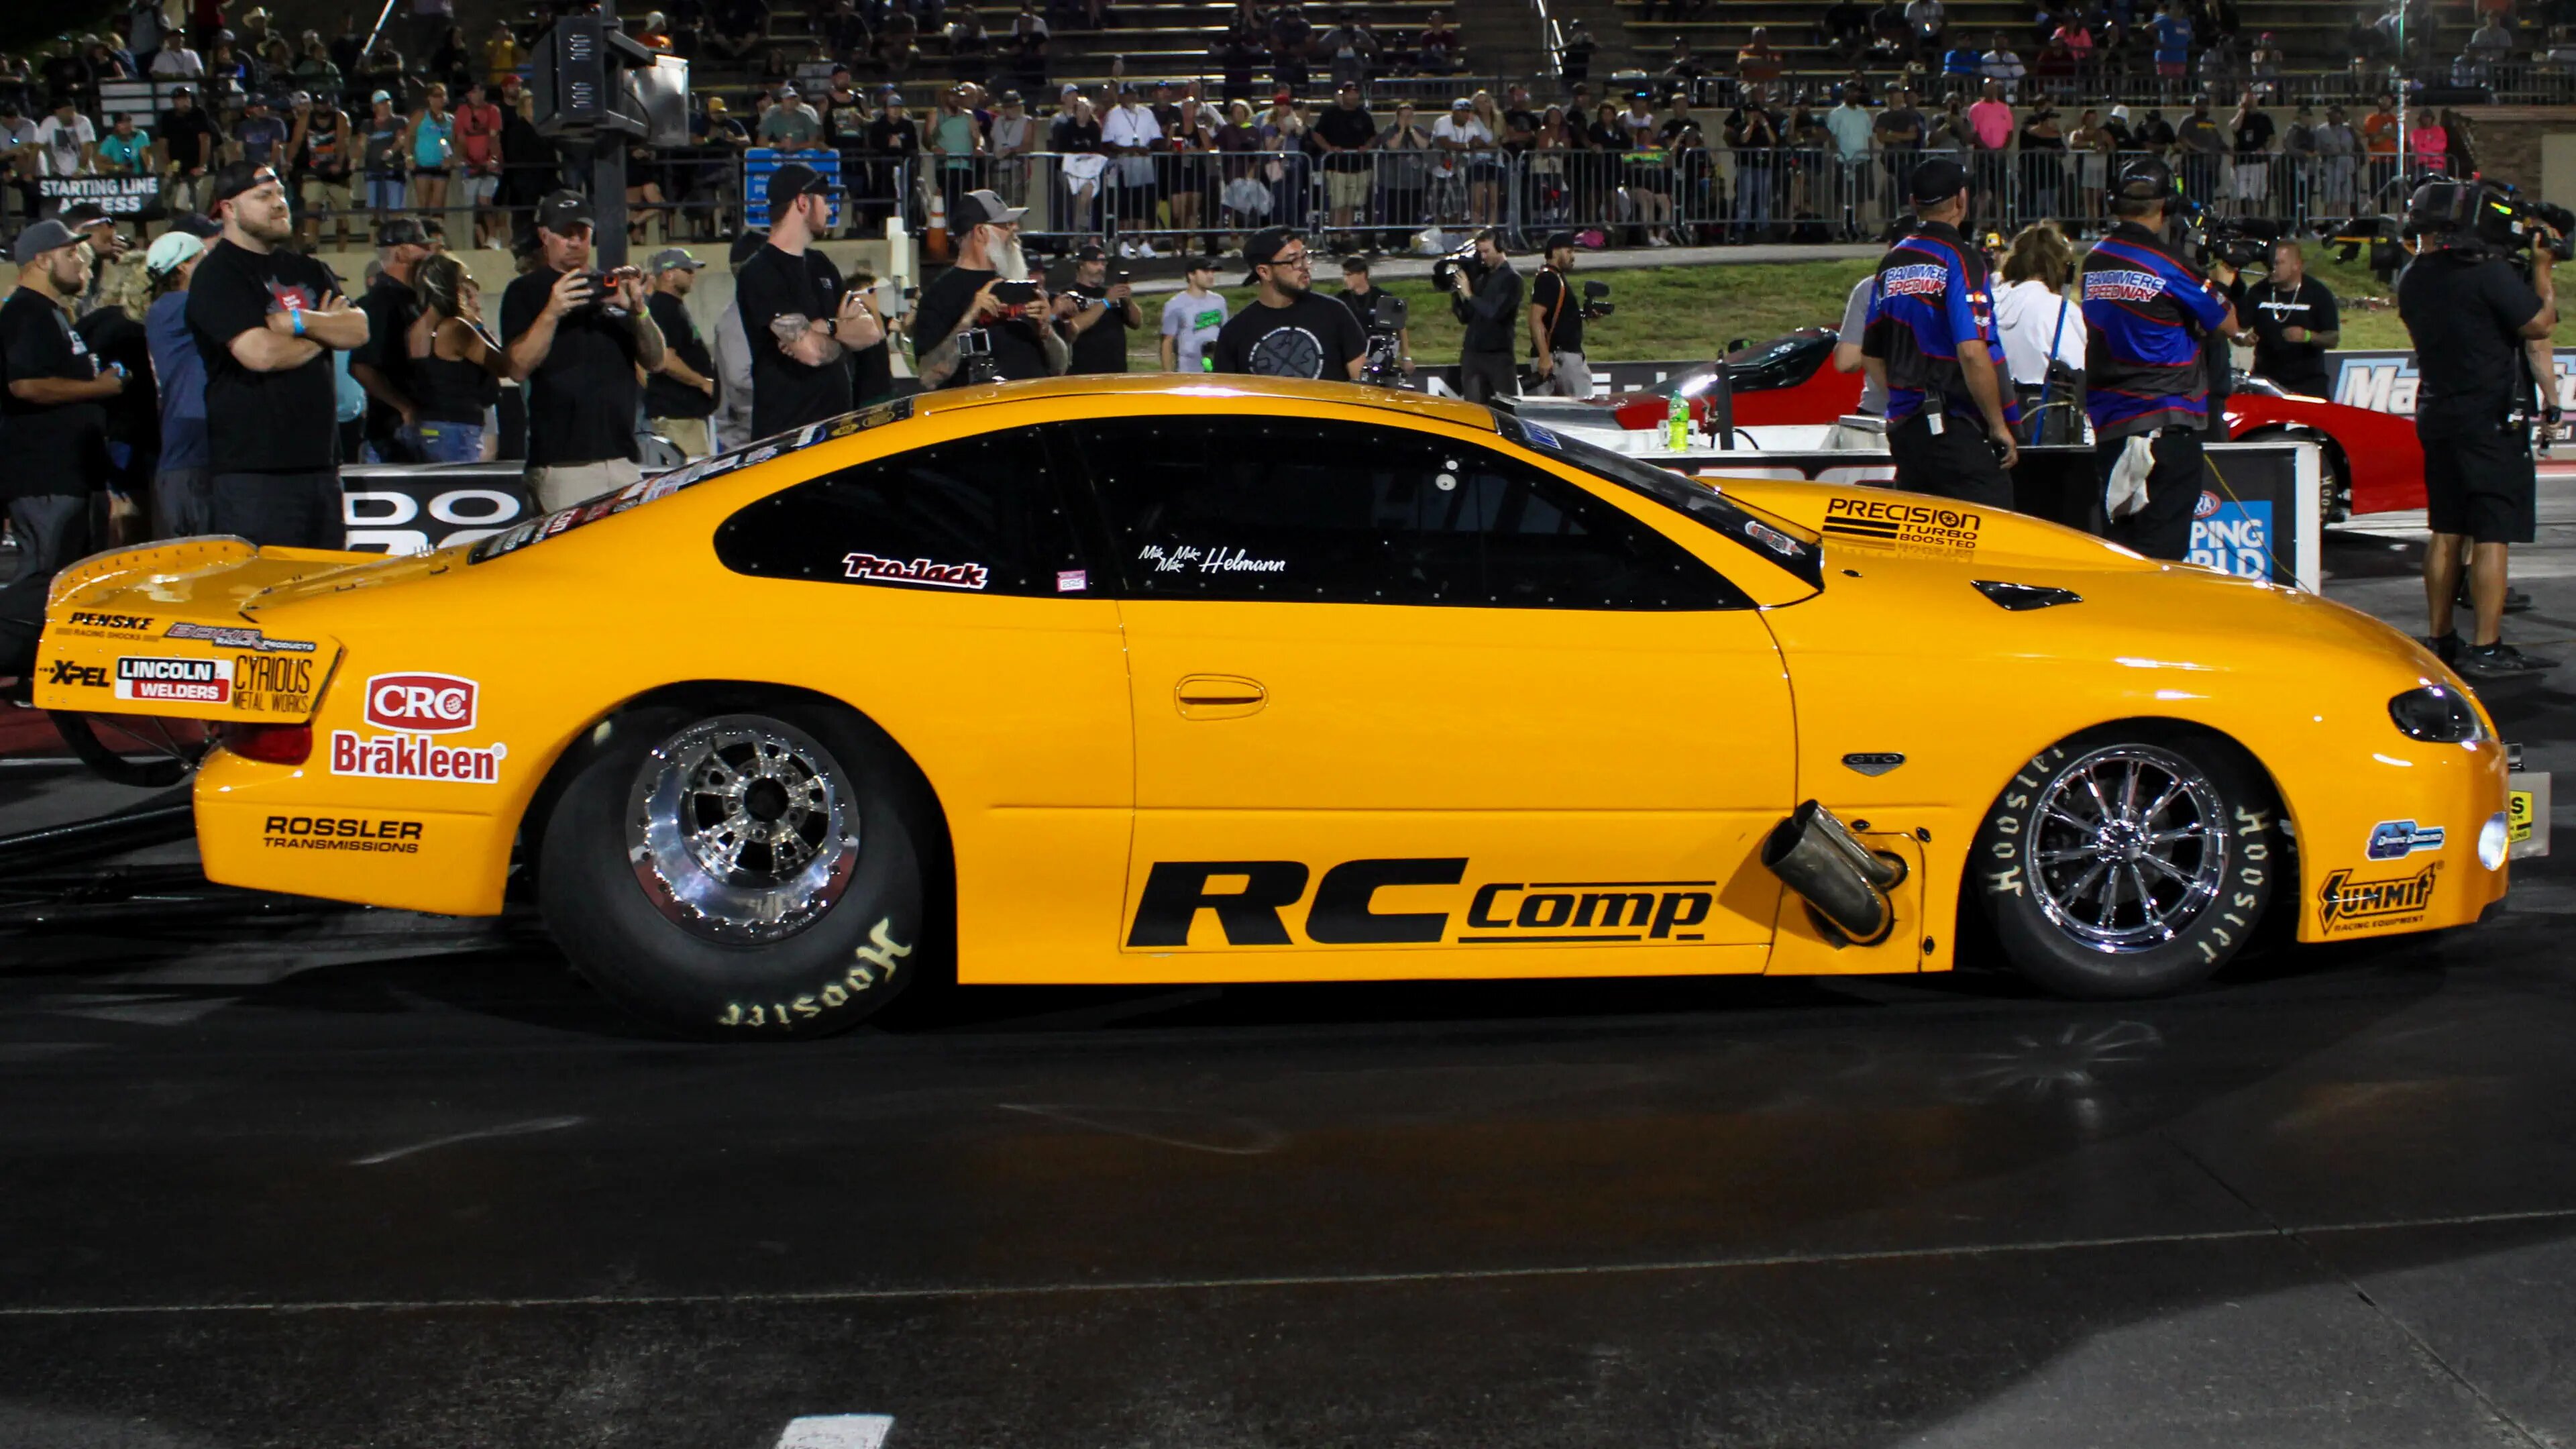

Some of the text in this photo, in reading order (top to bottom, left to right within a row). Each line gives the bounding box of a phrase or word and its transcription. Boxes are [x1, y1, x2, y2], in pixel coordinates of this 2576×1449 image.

[40, 177, 158, 197] STARTING LINE
[2531, 425, 2572, 440] Fel
[1827, 498, 1981, 531] PRECISION
[1900, 534, 1976, 549] BOOSTED
[1904, 524, 1977, 541] TURBO
[1199, 546, 1286, 574] Helmann
[69, 612, 154, 630] PENSKE
[74, 629, 142, 641] RACING SHOCKS
[262, 640, 315, 651] PRODUCTS
[50, 660, 111, 688] XPEL
[121, 659, 212, 681] LINCOLN
[234, 655, 313, 694] CYRIOUS
[140, 683, 219, 700] WELDERS
[233, 691, 309, 713] METAL WORKS
[374, 685, 467, 720] CRC
[1848, 755, 1900, 763] GTO
[264, 815, 423, 840] ROSSLER
[262, 837, 419, 854] TRANSMISSIONS
[1126, 857, 1715, 947] RC Comp
[2334, 914, 2424, 932] RACING EQUIPMENT
[718, 916, 912, 1028] Hoosier
